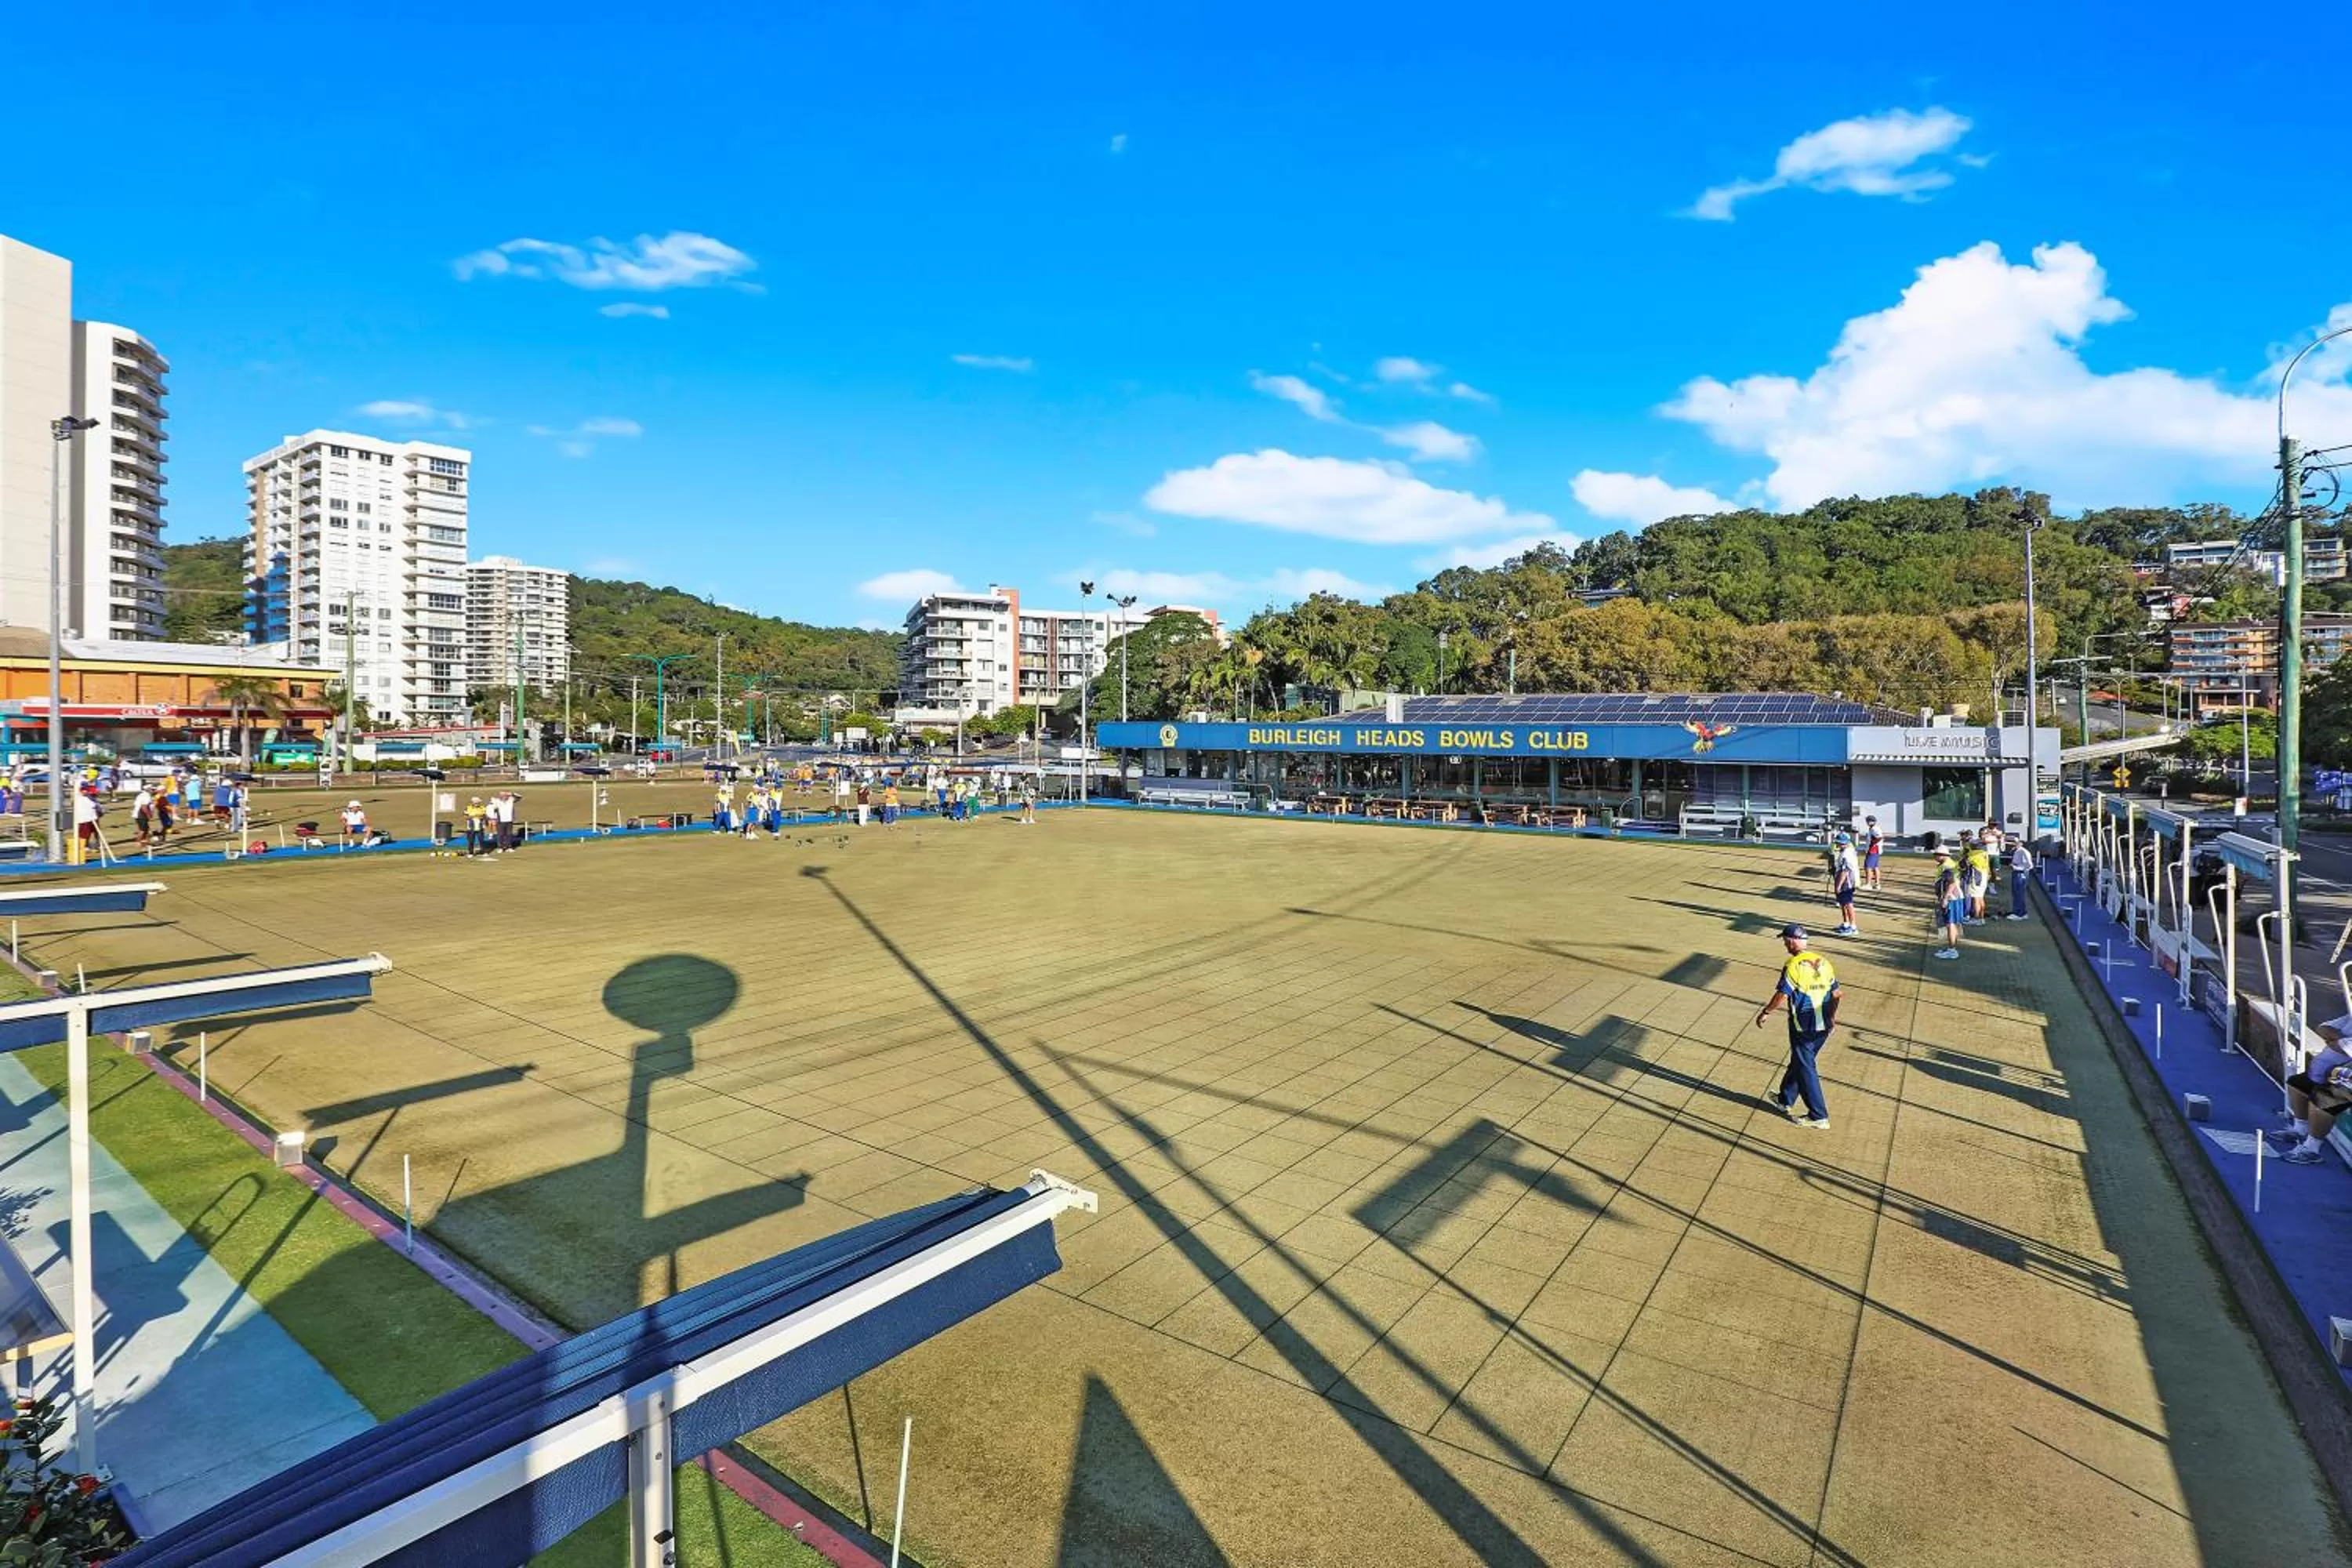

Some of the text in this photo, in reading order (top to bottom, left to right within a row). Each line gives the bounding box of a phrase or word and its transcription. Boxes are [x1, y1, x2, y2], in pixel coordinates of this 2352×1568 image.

[1248, 728, 1588, 750] BURLEIGH HEADS BOWLS CLUB
[1904, 735, 2001, 750] LIVE MUSIC
